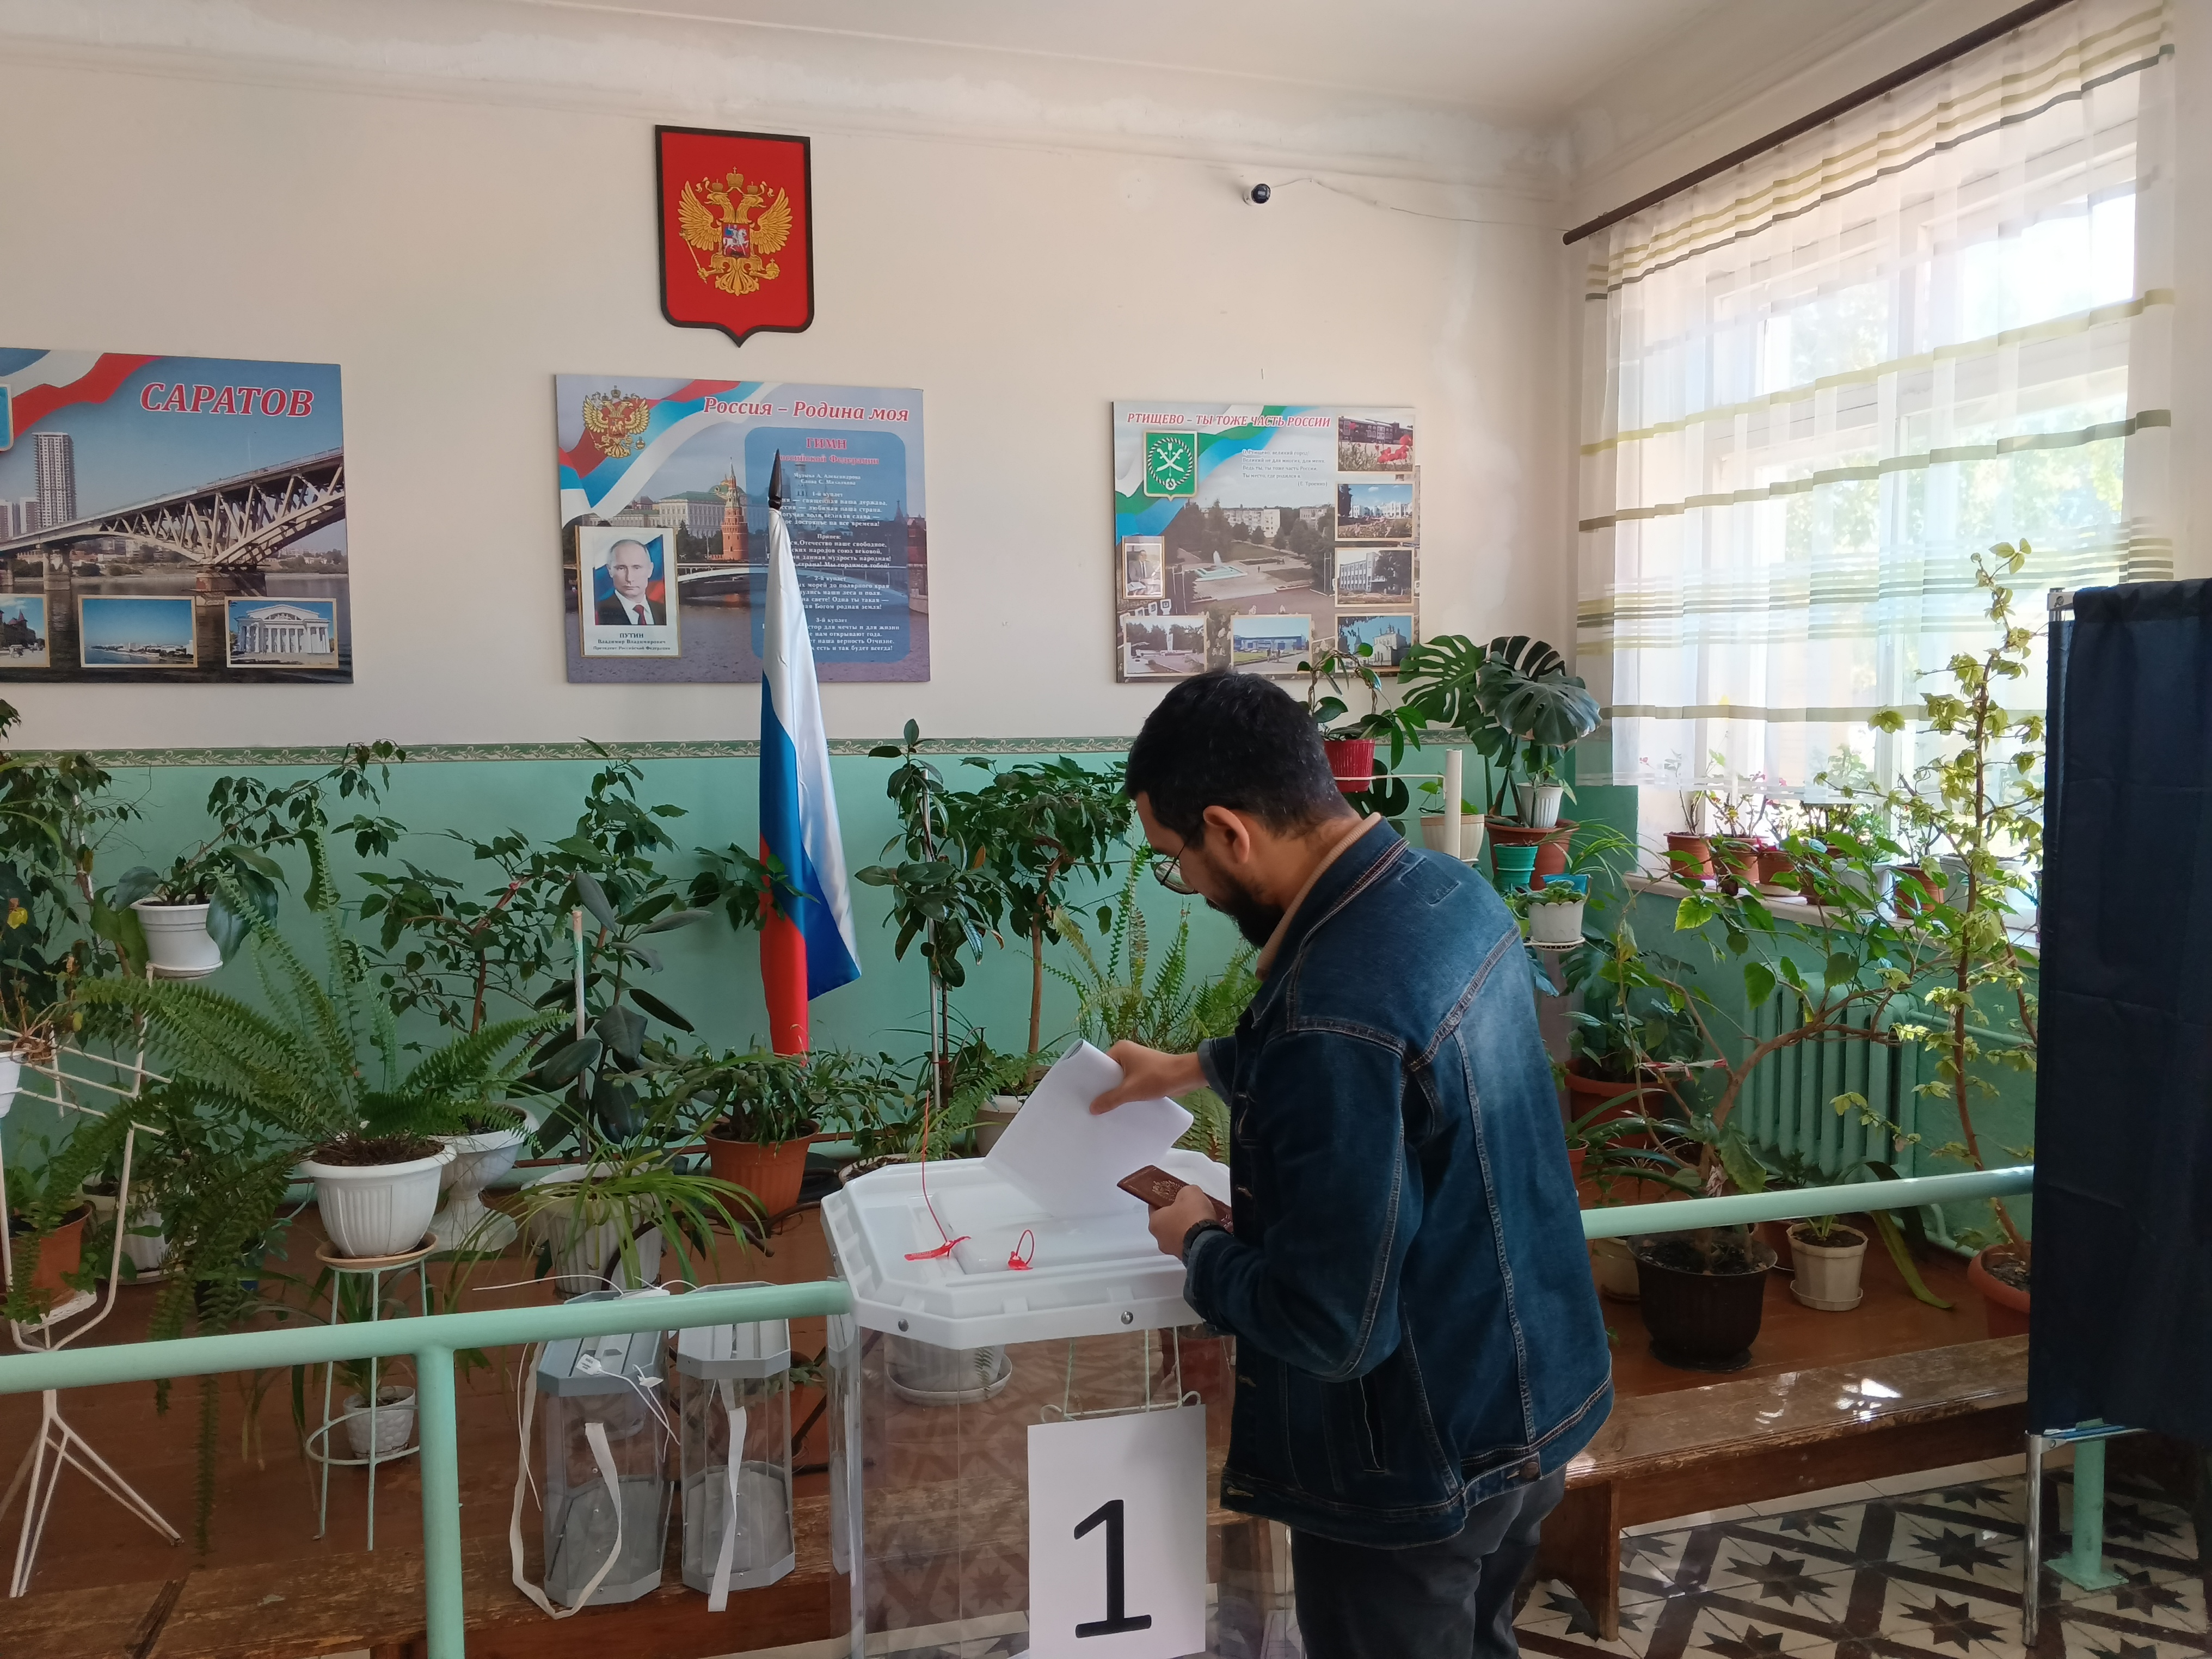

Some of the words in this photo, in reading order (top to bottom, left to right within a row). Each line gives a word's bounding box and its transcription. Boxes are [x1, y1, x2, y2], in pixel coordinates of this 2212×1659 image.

[140, 382, 314, 417] САРАТОВ
[704, 397, 772, 416] Россия
[792, 401, 864, 420] Родина
[868, 407, 908, 422] моя
[1127, 413, 1184, 425] РТИЩЕВО
[1196, 415, 1213, 425] ТЫ
[1216, 415, 1248, 426] ТОЖЕ
[1251, 416, 1285, 426] ЧАСТЬ
[1287, 417, 1331, 427] РОССИИ
[806, 438, 847, 450] ГИМН
[829, 454, 879, 465] Федерации
[1074, 1499, 1152, 1638] 1
